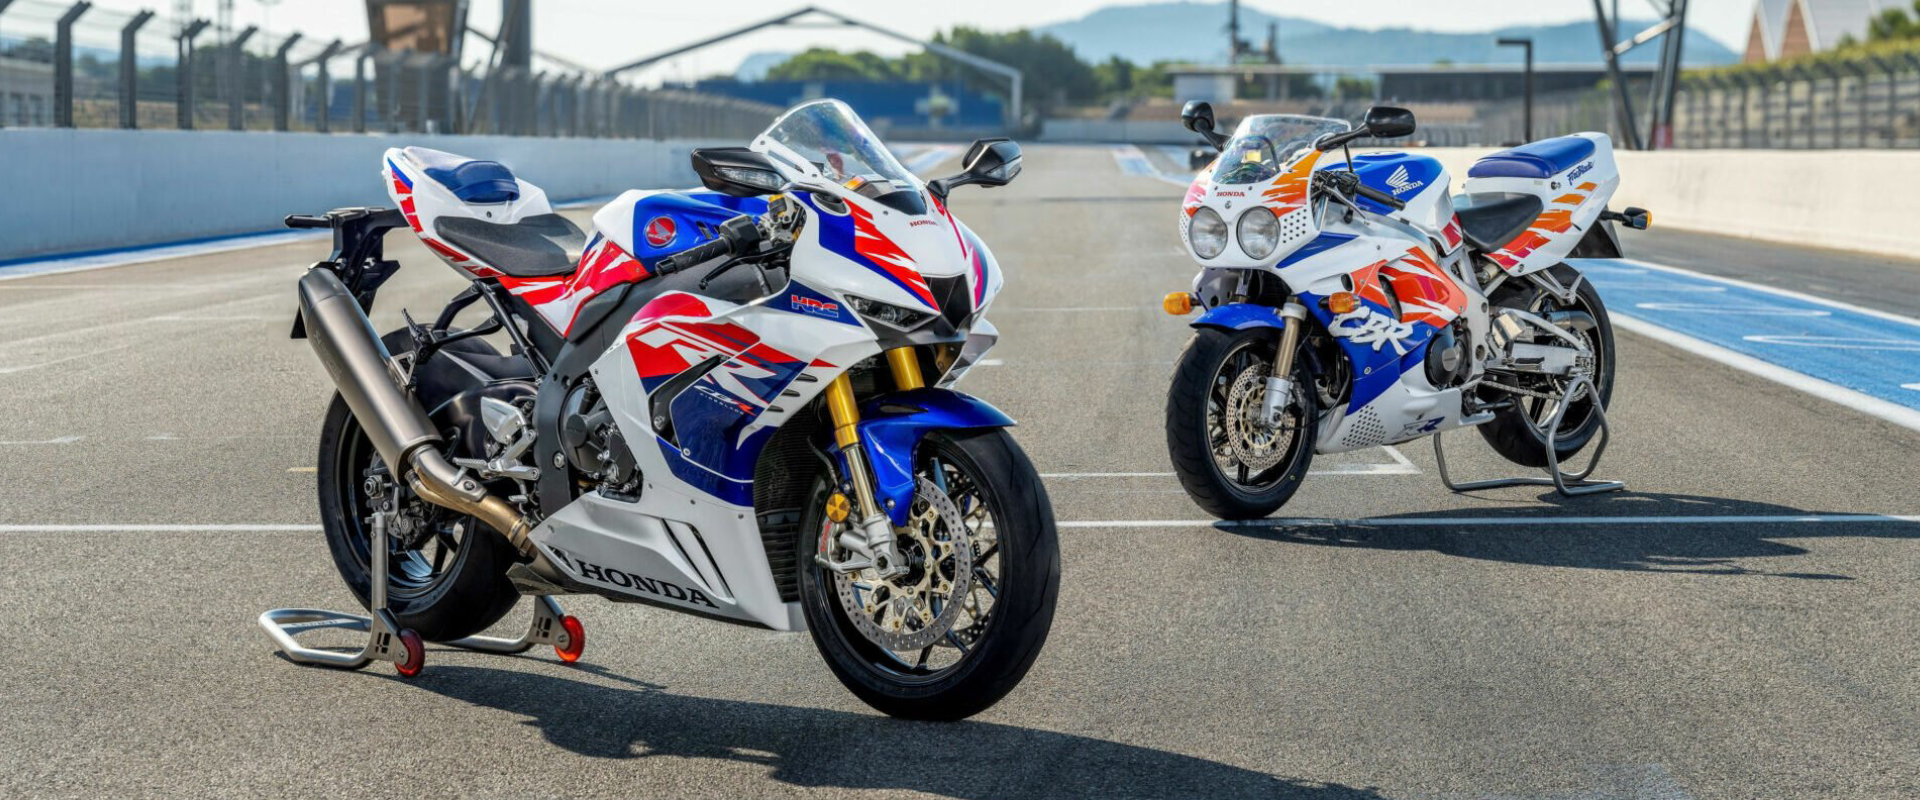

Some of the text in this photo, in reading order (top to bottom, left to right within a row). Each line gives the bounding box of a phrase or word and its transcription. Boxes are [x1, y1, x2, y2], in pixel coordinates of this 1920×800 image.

[1391, 180, 1424, 196] HONDA
[791, 294, 839, 318] HRC
[1328, 305, 1413, 356] CBR
[575, 558, 720, 609] HONDA
